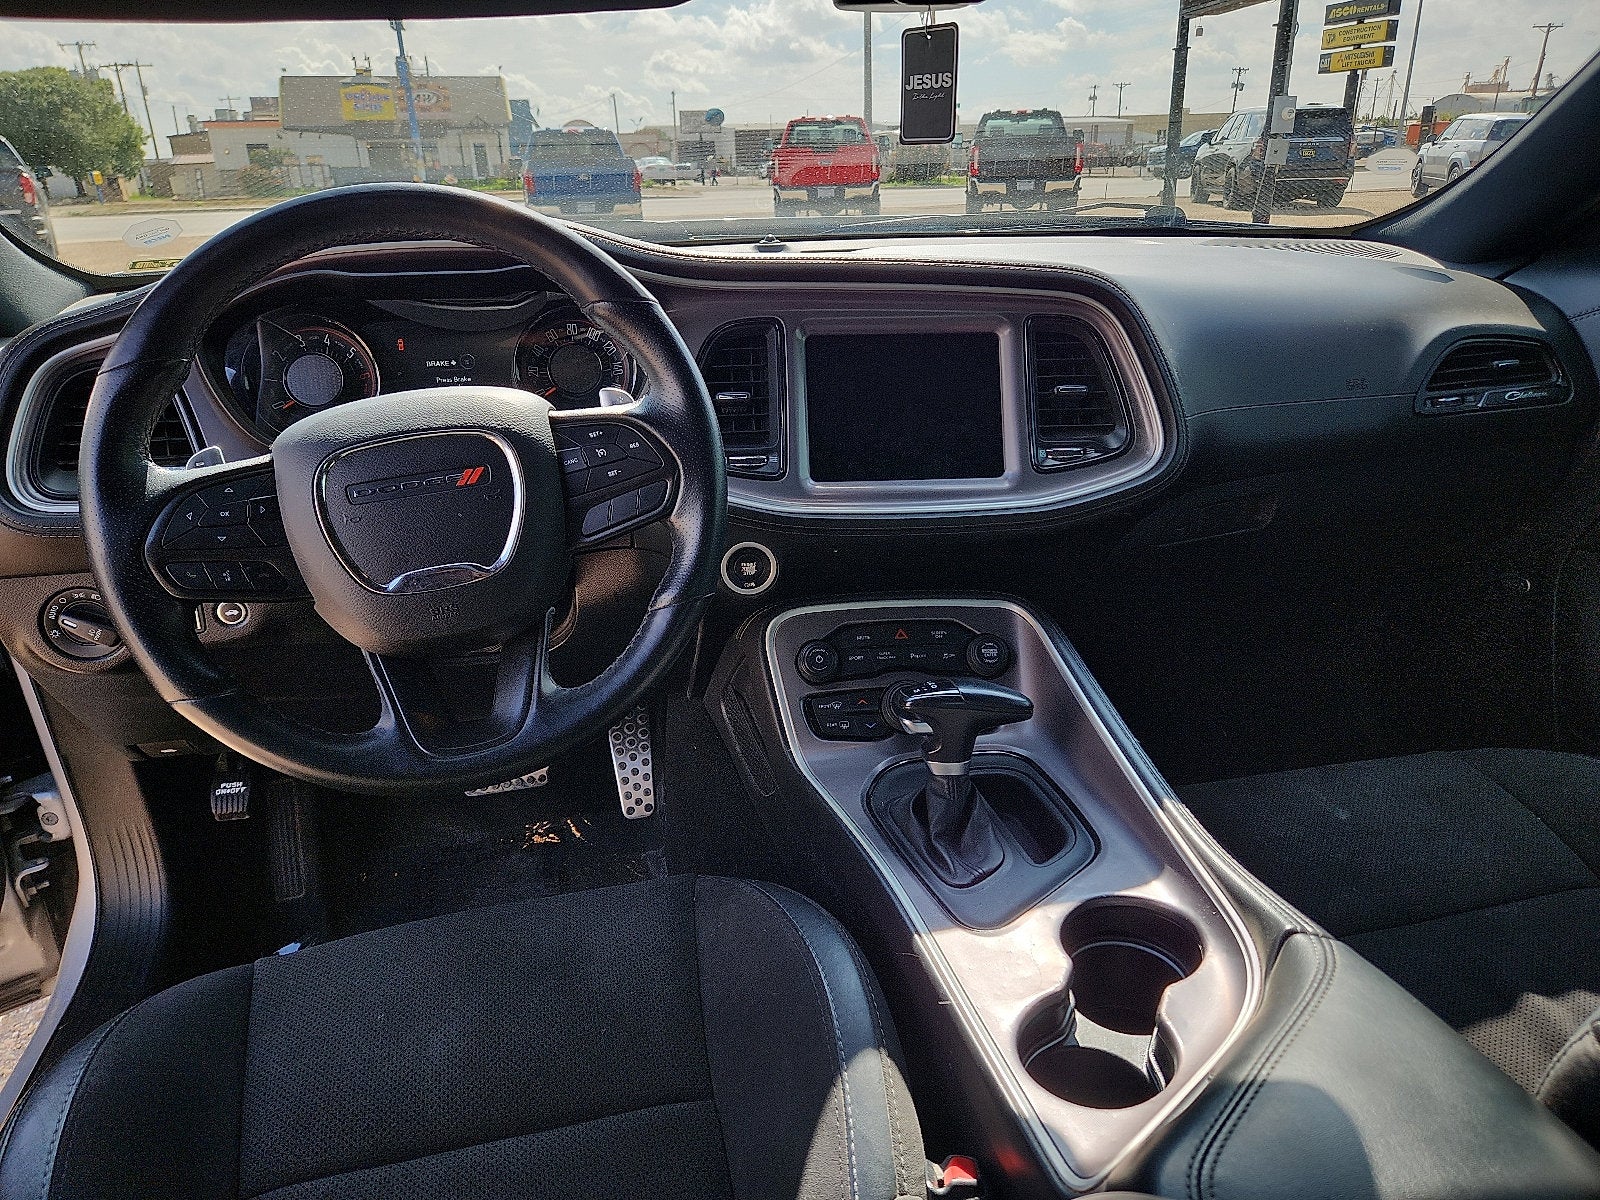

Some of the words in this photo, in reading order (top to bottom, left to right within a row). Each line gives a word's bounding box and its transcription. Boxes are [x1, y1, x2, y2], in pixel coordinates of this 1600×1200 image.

[1328, 5, 1357, 19] ASCO
[1357, 4, 1385, 13] RENTALS
[1339, 24, 1382, 36] CONSTRUCTION
[1343, 33, 1375, 42] EQUIPMENT
[1344, 51, 1375, 60] MITSUBISHI
[905, 72, 952, 90] JESUS
[545, 329, 558, 342] 60
[566, 324, 578, 335] 80
[586, 326, 602, 341] 100
[295, 334, 306, 347] 3
[323, 333, 331, 347] 4
[346, 347, 357, 359] 5
[602, 340, 617, 356] 120
[528, 365, 539, 377] 20
[612, 361, 623, 376] 140
[563, 458, 579, 466] CANC
[353, 473, 463, 496] DODGE
[220, 781, 244, 789] PUSH
